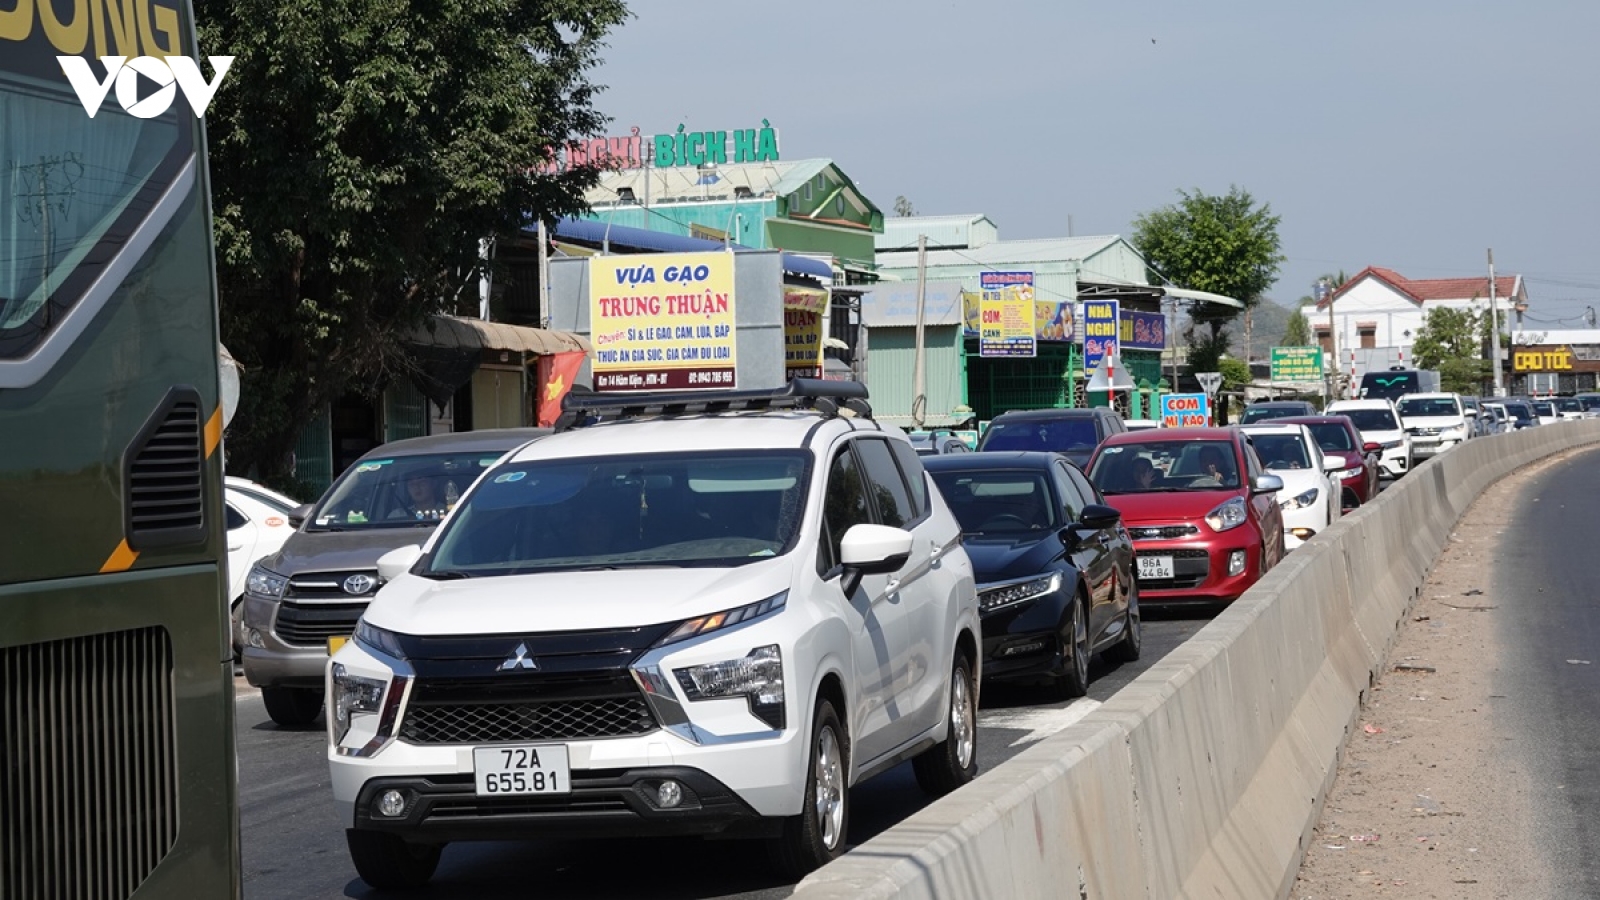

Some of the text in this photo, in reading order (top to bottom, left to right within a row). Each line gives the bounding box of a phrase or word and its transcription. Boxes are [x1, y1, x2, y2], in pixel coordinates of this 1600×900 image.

[654, 123, 727, 168] BÍCH
[734, 118, 780, 162] HÀ
[616, 264, 709, 289] VỰA GẠO
[599, 288, 729, 319] TRUNG THUẬN
[1087, 303, 1113, 319] NHÀ
[638, 330, 644, 341] &
[1086, 319, 1116, 337] NGHỈ
[632, 350, 645, 362] GIA
[666, 347, 679, 360] GIA
[1514, 345, 1572, 371] CAO TỐC
[1142, 558, 1161, 568] 86A
[501, 748, 541, 769] 72A
[486, 771, 557, 793] 655.81
